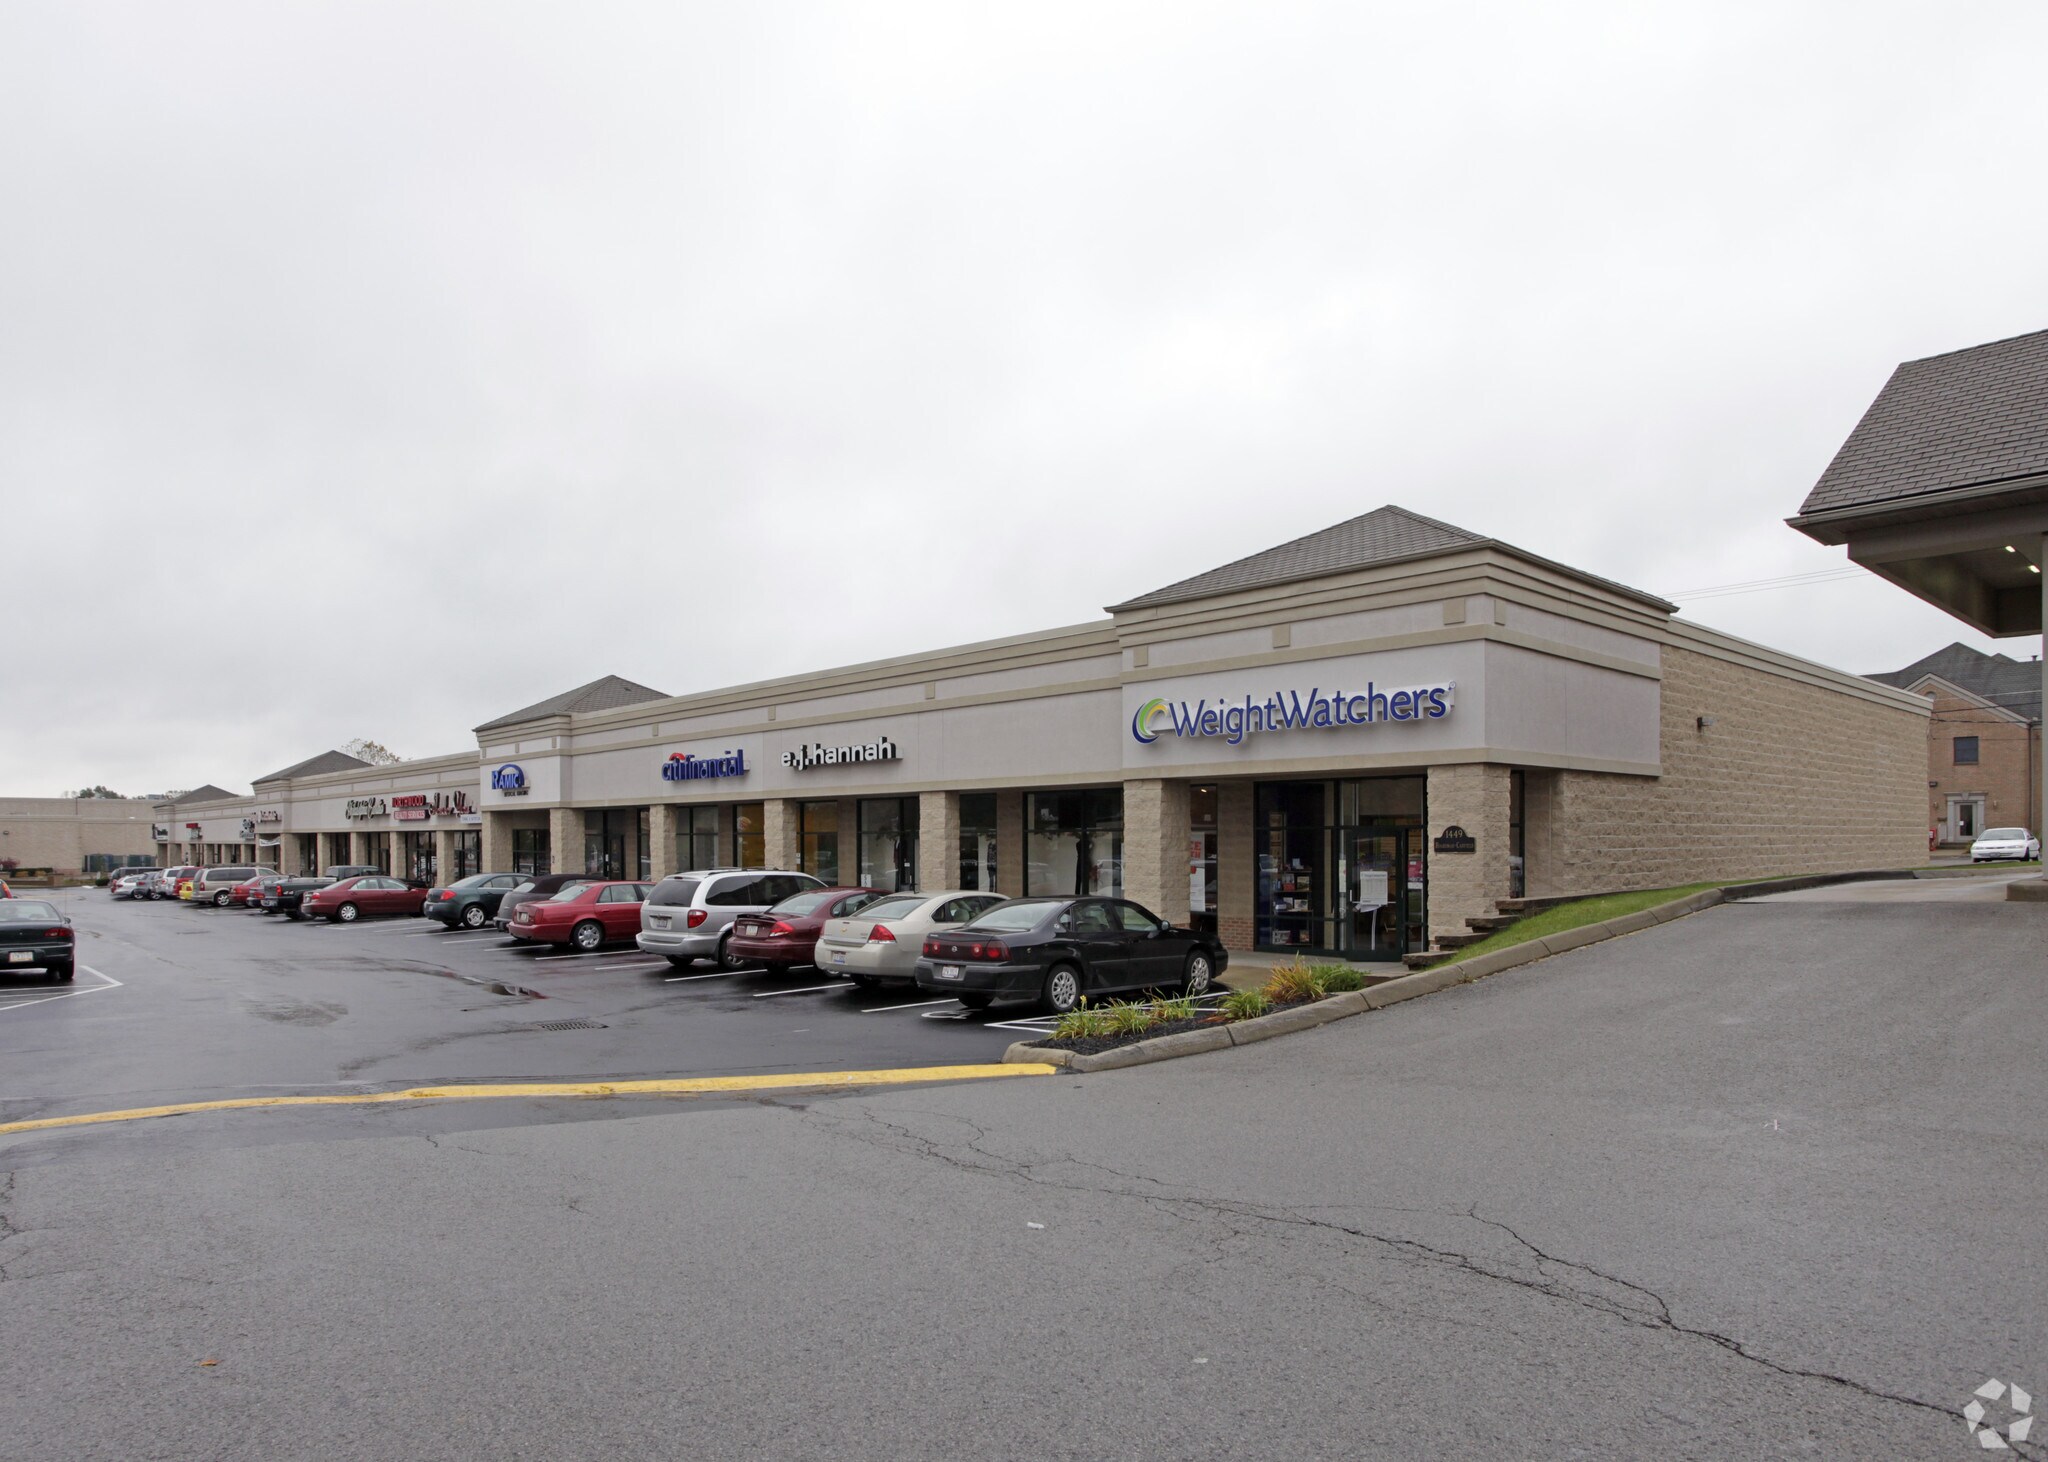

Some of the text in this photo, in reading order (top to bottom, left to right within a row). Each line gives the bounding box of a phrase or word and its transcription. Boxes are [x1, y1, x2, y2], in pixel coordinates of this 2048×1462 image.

[1168, 681, 1449, 745] WeightWatchers
[491, 770, 519, 790] RAMIC
[1445, 829, 1463, 839] 1449
